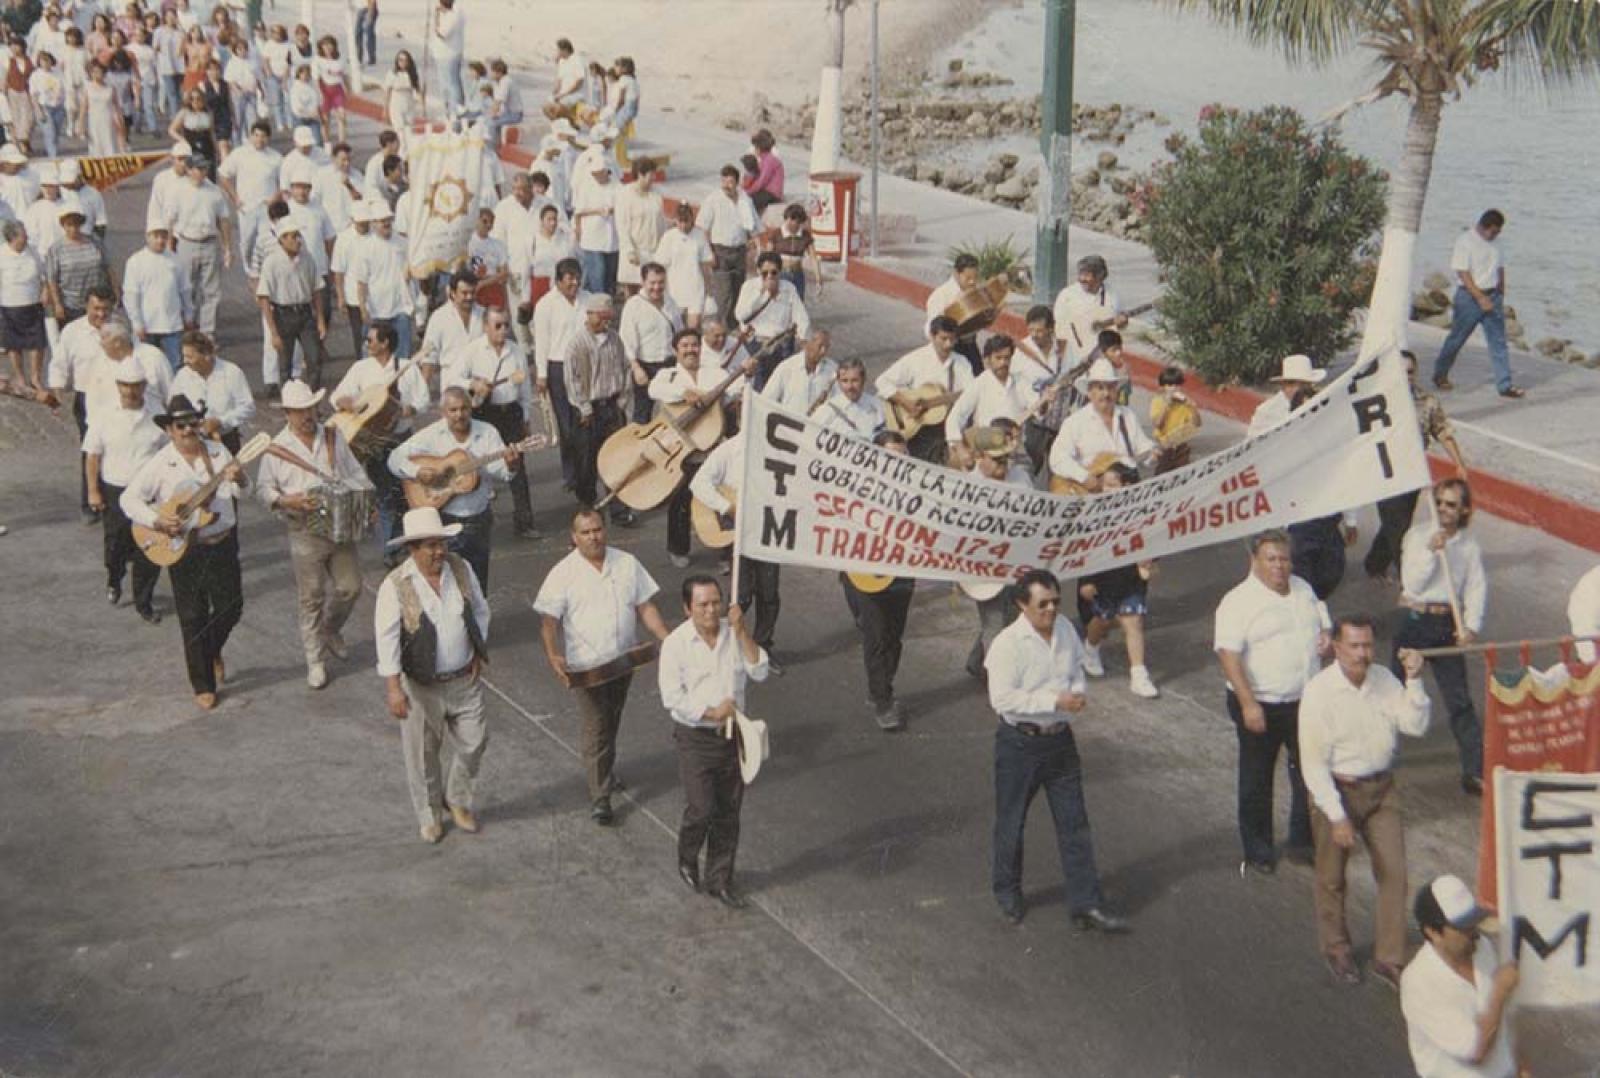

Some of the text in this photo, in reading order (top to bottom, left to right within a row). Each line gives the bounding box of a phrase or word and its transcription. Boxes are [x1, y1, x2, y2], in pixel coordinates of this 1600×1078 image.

[761, 412, 804, 550] CTM
[807, 459, 923, 515] GOBIERNO
[928, 505, 1039, 538] ACCIONES
[815, 427, 916, 484] COMBATIR
[920, 468, 945, 494] LA
[951, 478, 1058, 518] INFLACION
[813, 492, 940, 548] SECCION
[954, 537, 1011, 560] 174
[1112, 532, 1144, 558] LA
[1167, 490, 1272, 540] MUSICA
[1511, 781, 1598, 968] CTM
